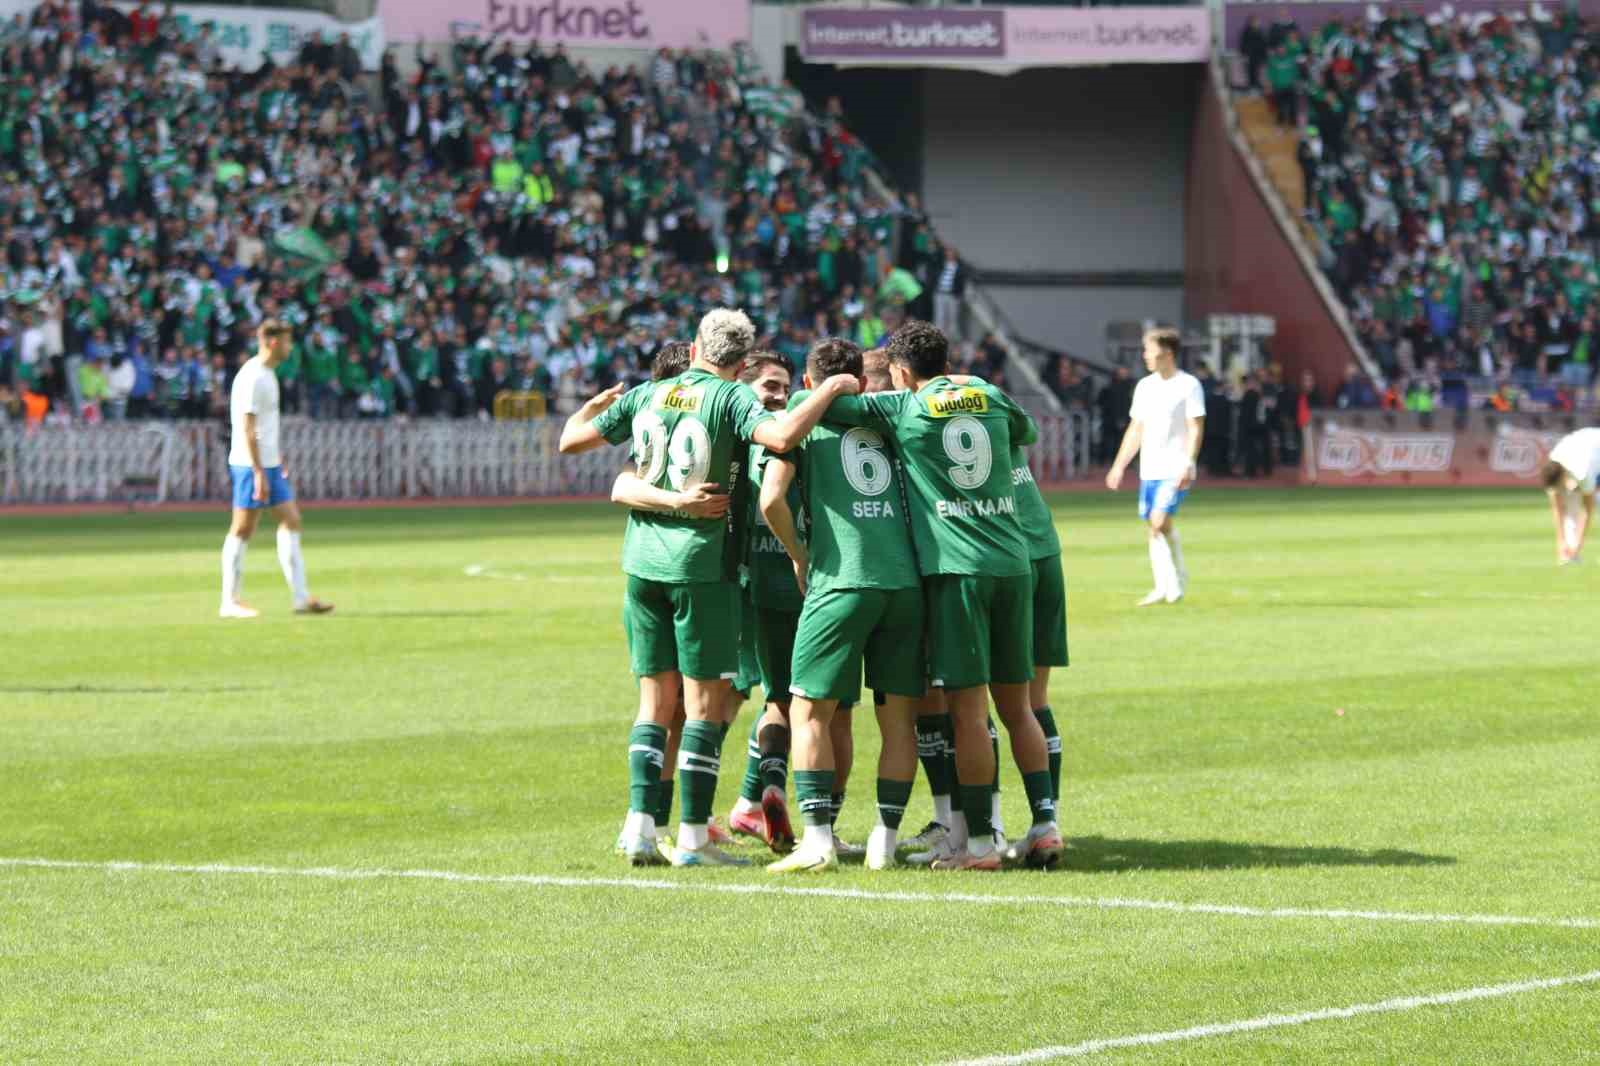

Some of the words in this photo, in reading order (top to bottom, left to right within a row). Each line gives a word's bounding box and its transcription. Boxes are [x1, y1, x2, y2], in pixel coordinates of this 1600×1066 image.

[841, 426, 892, 496] 6
[942, 415, 993, 490] 9
[852, 500, 895, 518] SEFA
